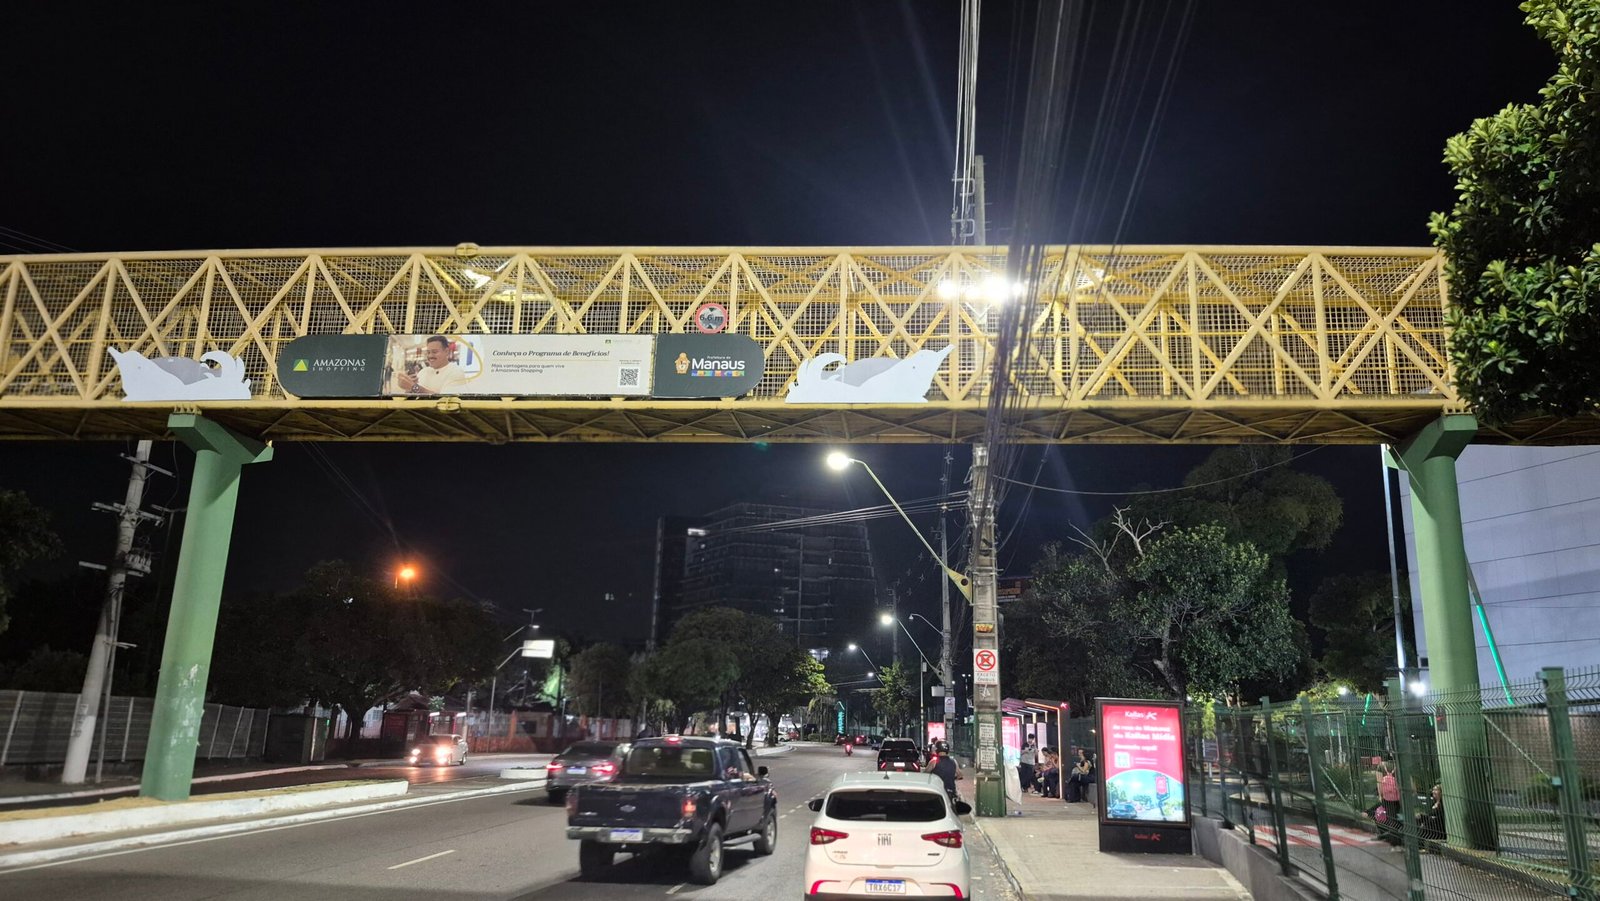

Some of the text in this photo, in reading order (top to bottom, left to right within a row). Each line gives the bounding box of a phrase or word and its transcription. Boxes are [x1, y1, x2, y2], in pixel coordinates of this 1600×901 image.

[492, 350, 521, 358] Conheça
[572, 350, 610, 358] Benefícios!
[313, 358, 366, 366] AMAZONAS
[691, 358, 745, 370] Manaus
[877, 833, 892, 846] FIAT
[869, 883, 902, 892] TRX6C17
